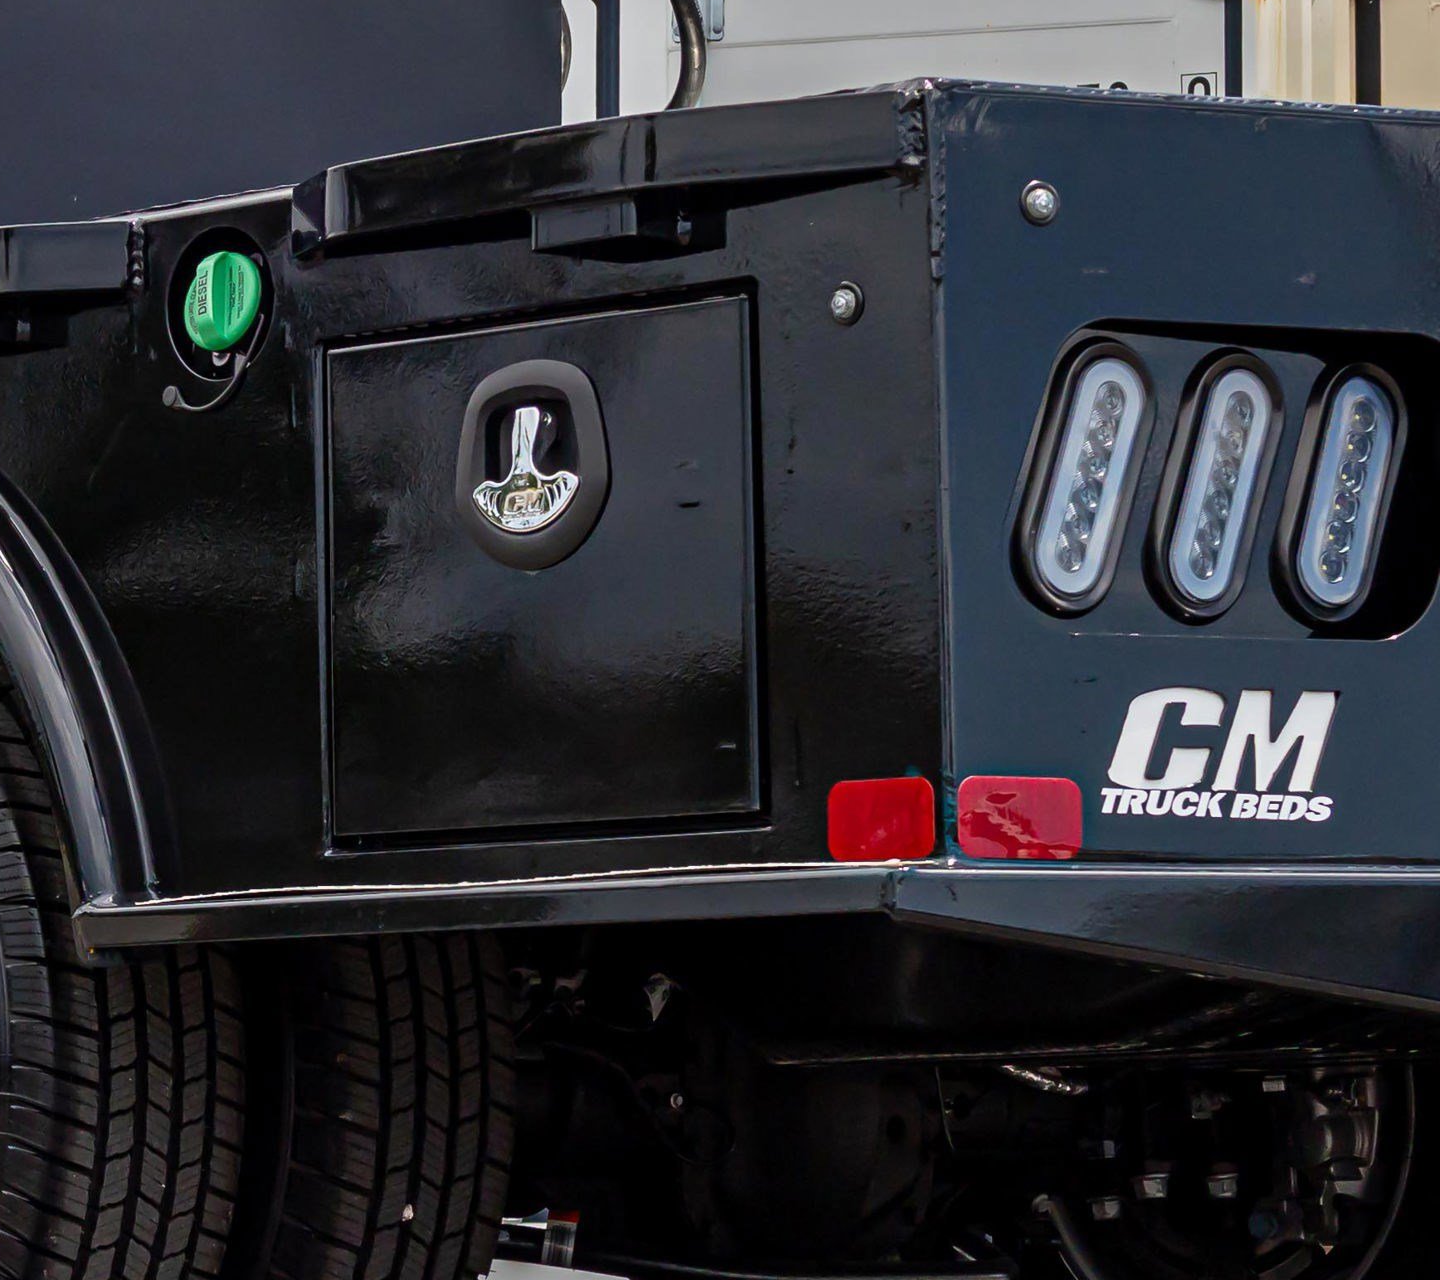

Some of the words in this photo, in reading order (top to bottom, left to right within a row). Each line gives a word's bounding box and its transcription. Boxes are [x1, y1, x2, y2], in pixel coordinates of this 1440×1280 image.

[198, 270, 209, 316] DIESEL
[1107, 686, 1338, 793] CM
[1100, 787, 1227, 818] TRUCK
[1230, 793, 1334, 822] BEDS
